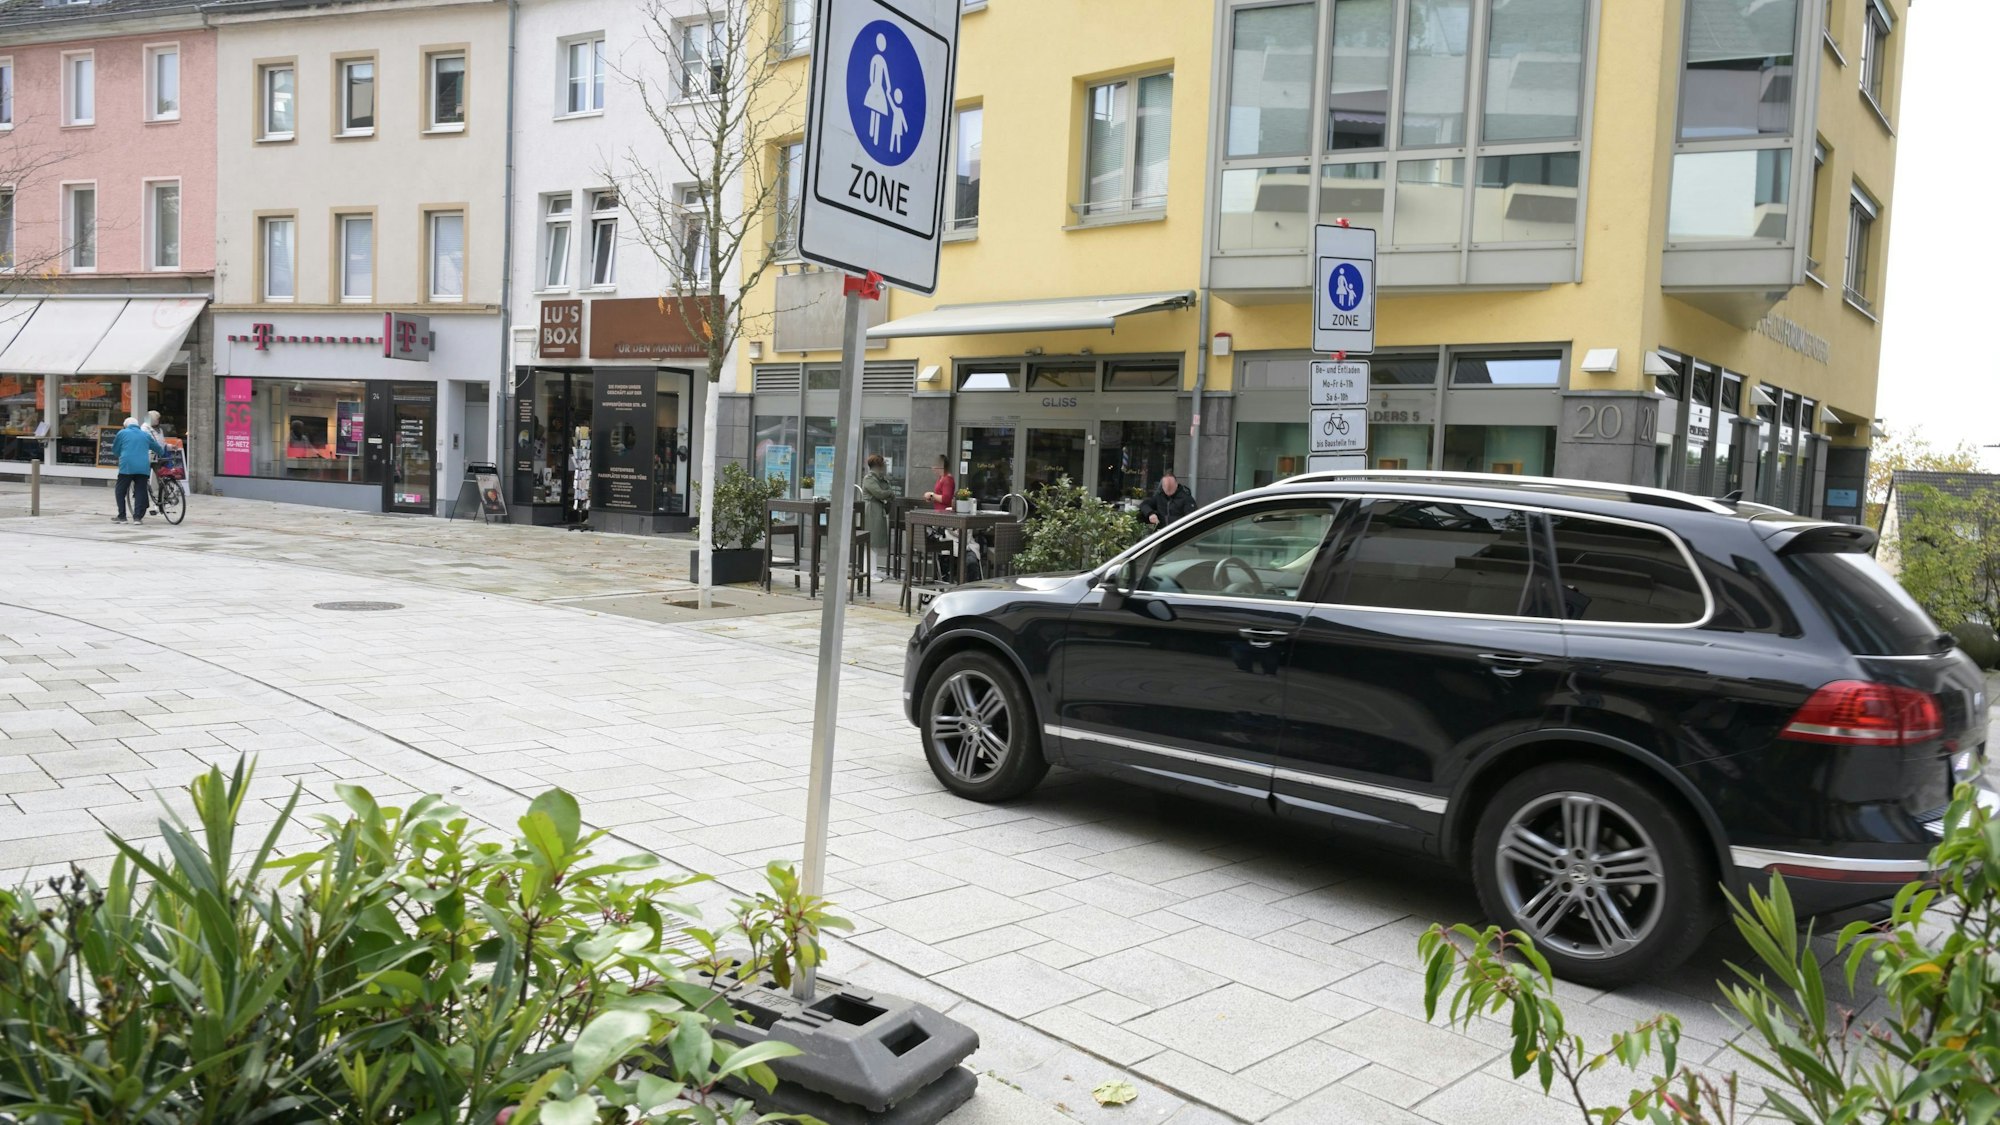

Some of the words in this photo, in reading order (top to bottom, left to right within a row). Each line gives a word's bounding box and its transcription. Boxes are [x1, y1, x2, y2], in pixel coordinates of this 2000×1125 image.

[848, 163, 910, 217] ZONE
[544, 305, 580, 324] LU'S
[1332, 314, 1359, 327] ZONE
[543, 327, 578, 345] BOX
[632, 343, 651, 353] DEN
[652, 343, 682, 353] MANN
[684, 343, 700, 353] MIT
[1315, 364, 1325, 374] Be-
[1326, 364, 1337, 374] und
[1337, 364, 1361, 374] Entladen
[1322, 379, 1339, 388] Mo-Fr
[1042, 396, 1077, 408] GLISS
[1326, 392, 1333, 401] Sa
[224, 403, 252, 423] 5G
[1368, 410, 1408, 422] LDERS
[1412, 410, 1420, 422] 5
[1573, 404, 1623, 440] 20
[1640, 405, 1657, 442] 20
[1316, 439, 1324, 448] bis
[1325, 438, 1347, 448] Baustelle
[1347, 438, 1357, 446] frei
